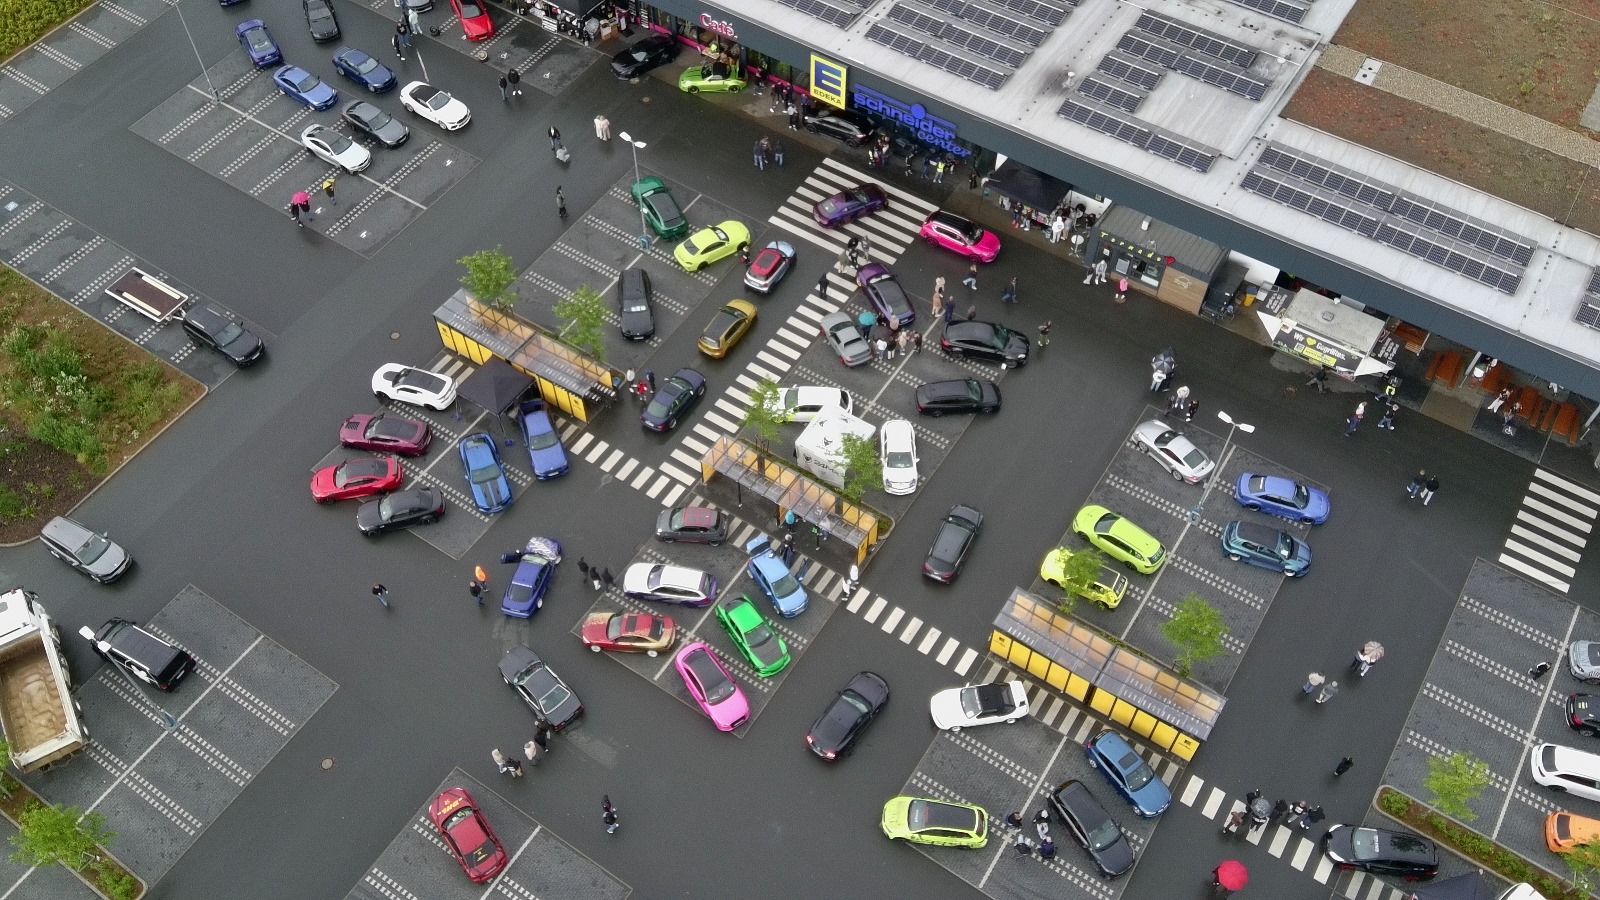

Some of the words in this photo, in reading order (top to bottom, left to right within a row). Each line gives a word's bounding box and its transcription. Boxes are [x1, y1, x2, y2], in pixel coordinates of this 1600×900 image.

[813, 88, 842, 105] EDEKA
[853, 92, 956, 140] schneider
[917, 130, 972, 158] center
[1293, 332, 1305, 342] Wir
